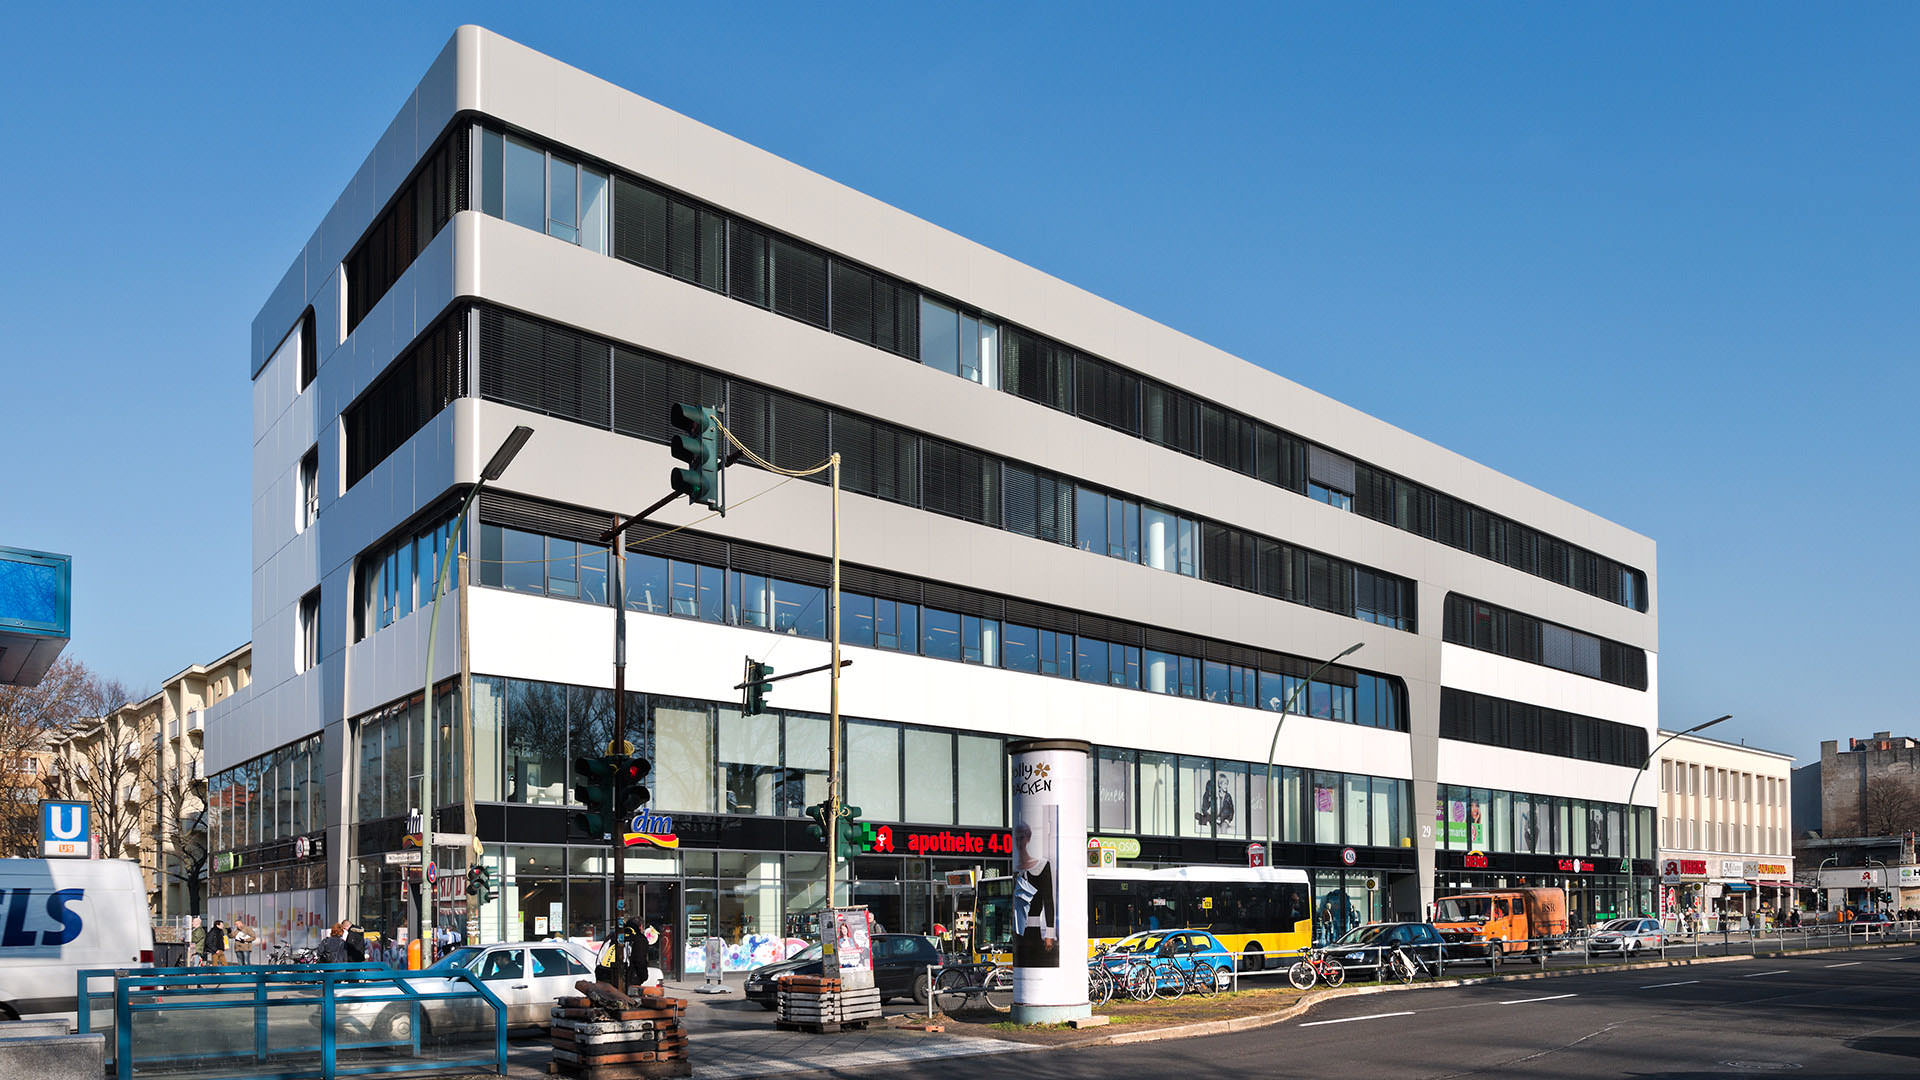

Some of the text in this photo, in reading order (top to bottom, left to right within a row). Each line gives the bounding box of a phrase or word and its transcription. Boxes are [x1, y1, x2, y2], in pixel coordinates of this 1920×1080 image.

[51, 806, 82, 840] U
[631, 808, 672, 834] dm
[1422, 825, 1432, 838] 29
[908, 832, 984, 855] apotheke
[0, 888, 85, 946] LS
